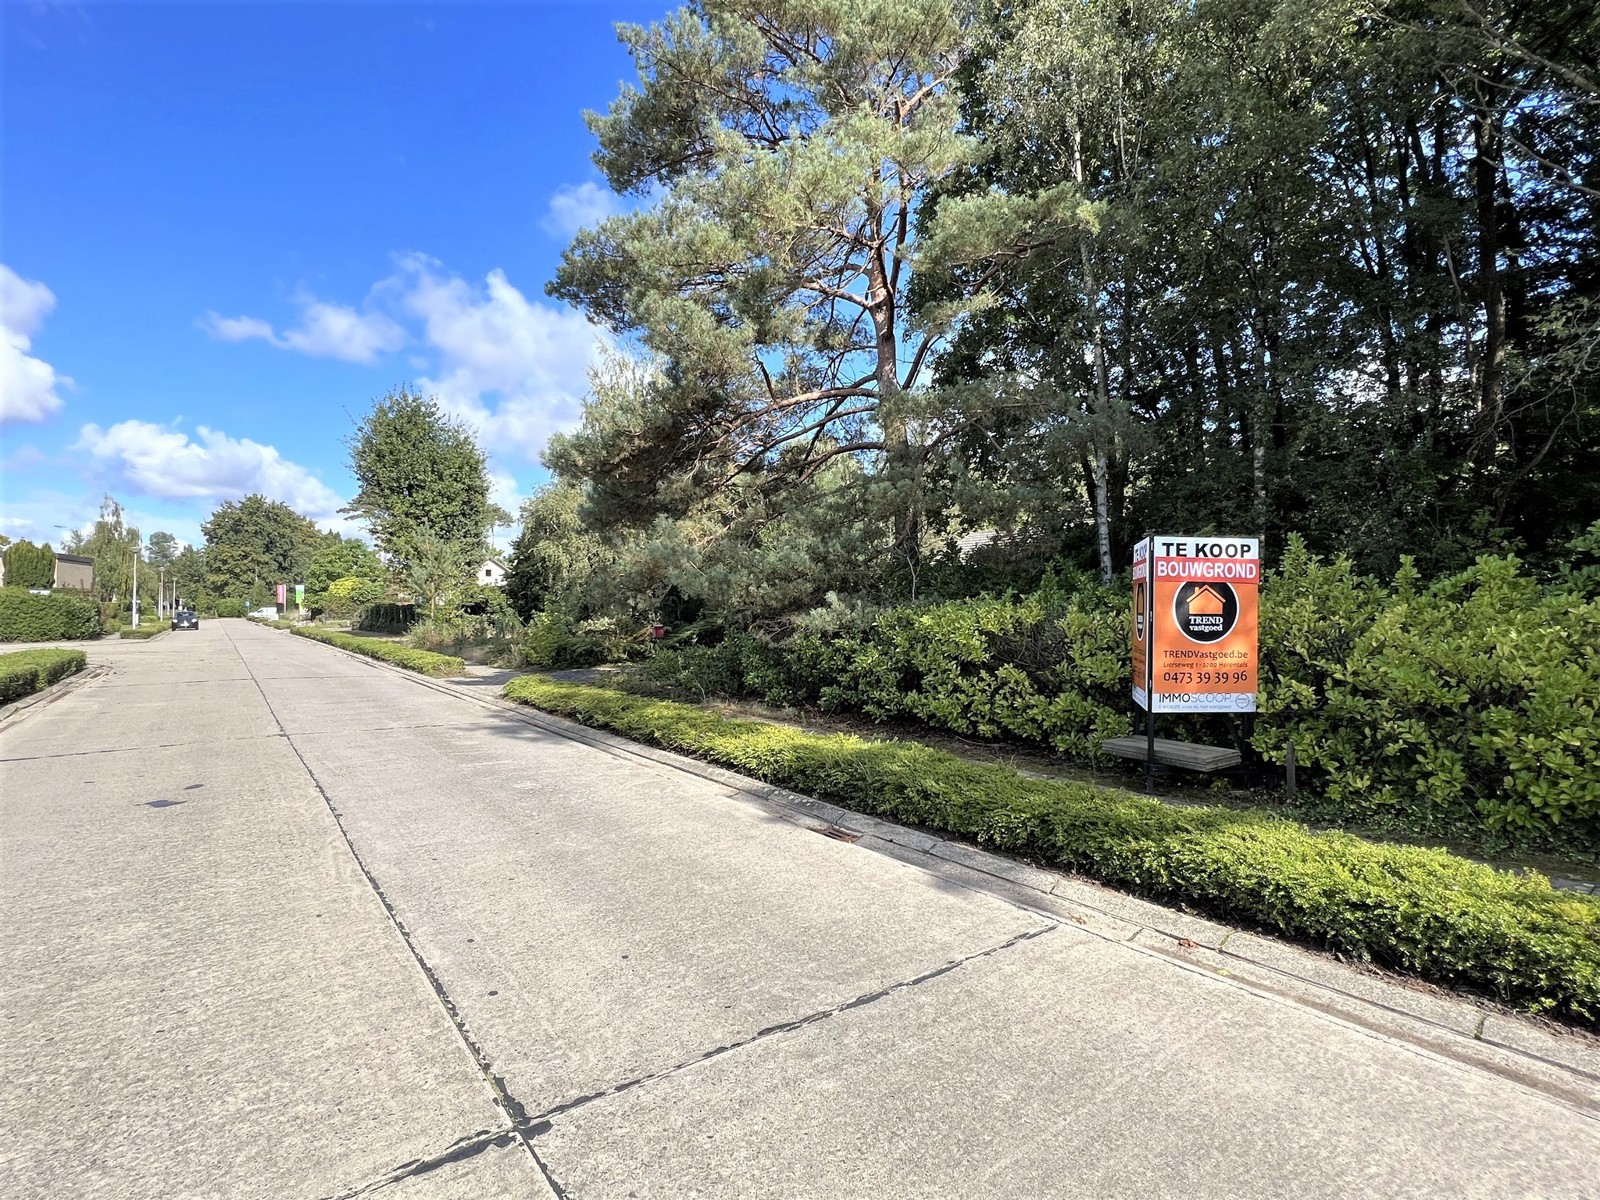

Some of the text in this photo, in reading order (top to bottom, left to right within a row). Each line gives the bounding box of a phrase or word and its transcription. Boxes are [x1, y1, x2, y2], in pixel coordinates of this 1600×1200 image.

[1162, 543, 1187, 557] TE
[1195, 543, 1251, 558] KOOP
[1157, 561, 1256, 578] BOUWGROND
[1189, 616, 1223, 624] TREND
[1189, 624, 1222, 632] vastgoed
[1163, 650, 1248, 660] TRENDVastgoed.be
[1163, 670, 1248, 684] 0473 39 39 96
